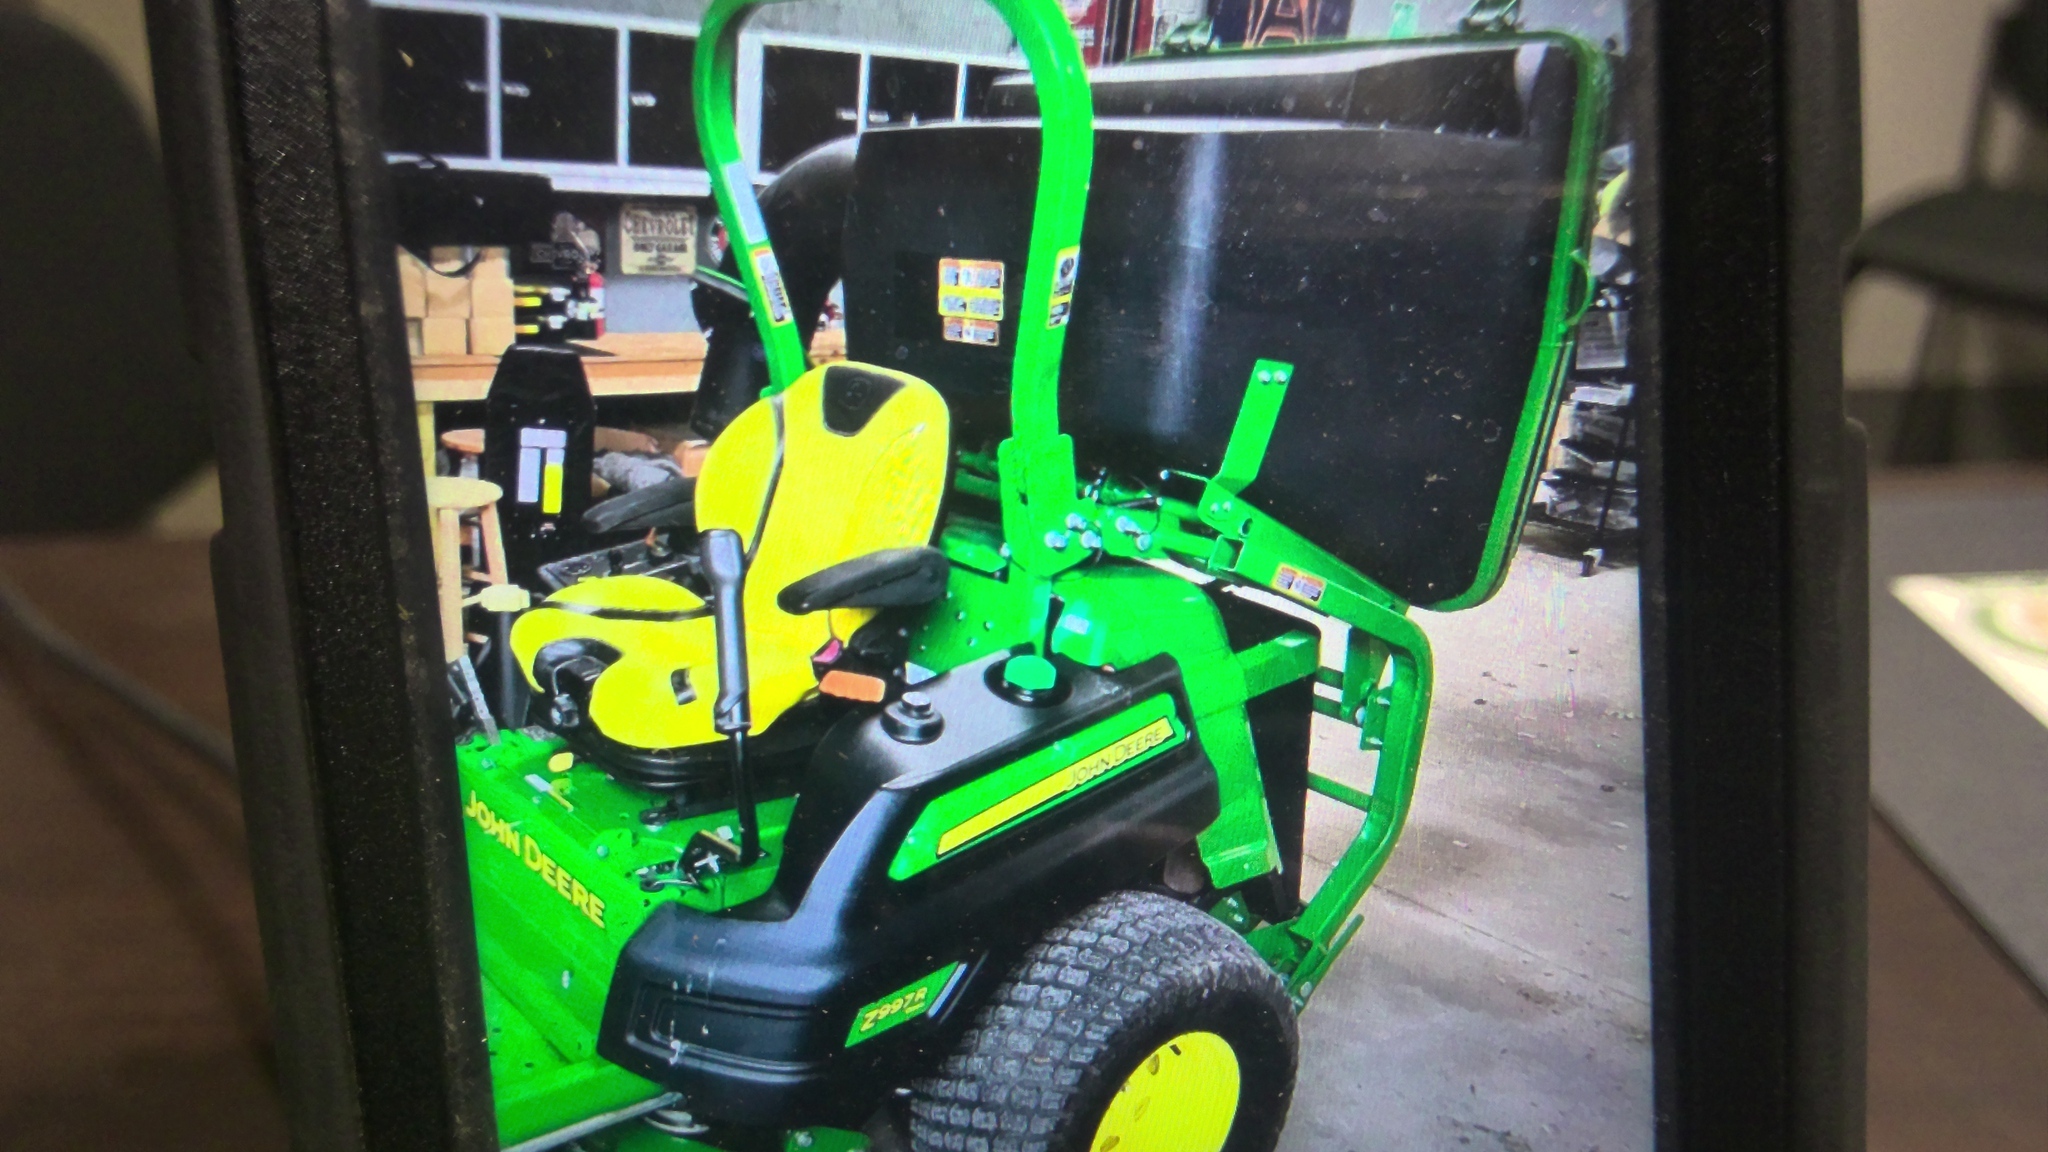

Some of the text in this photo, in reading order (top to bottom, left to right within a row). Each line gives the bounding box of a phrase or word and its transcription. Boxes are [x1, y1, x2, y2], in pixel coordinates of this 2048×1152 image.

[1067, 727, 1163, 788] JOHN DEERE
[465, 789, 606, 929] JOHN DEERE
[860, 986, 928, 1032] Z997R
